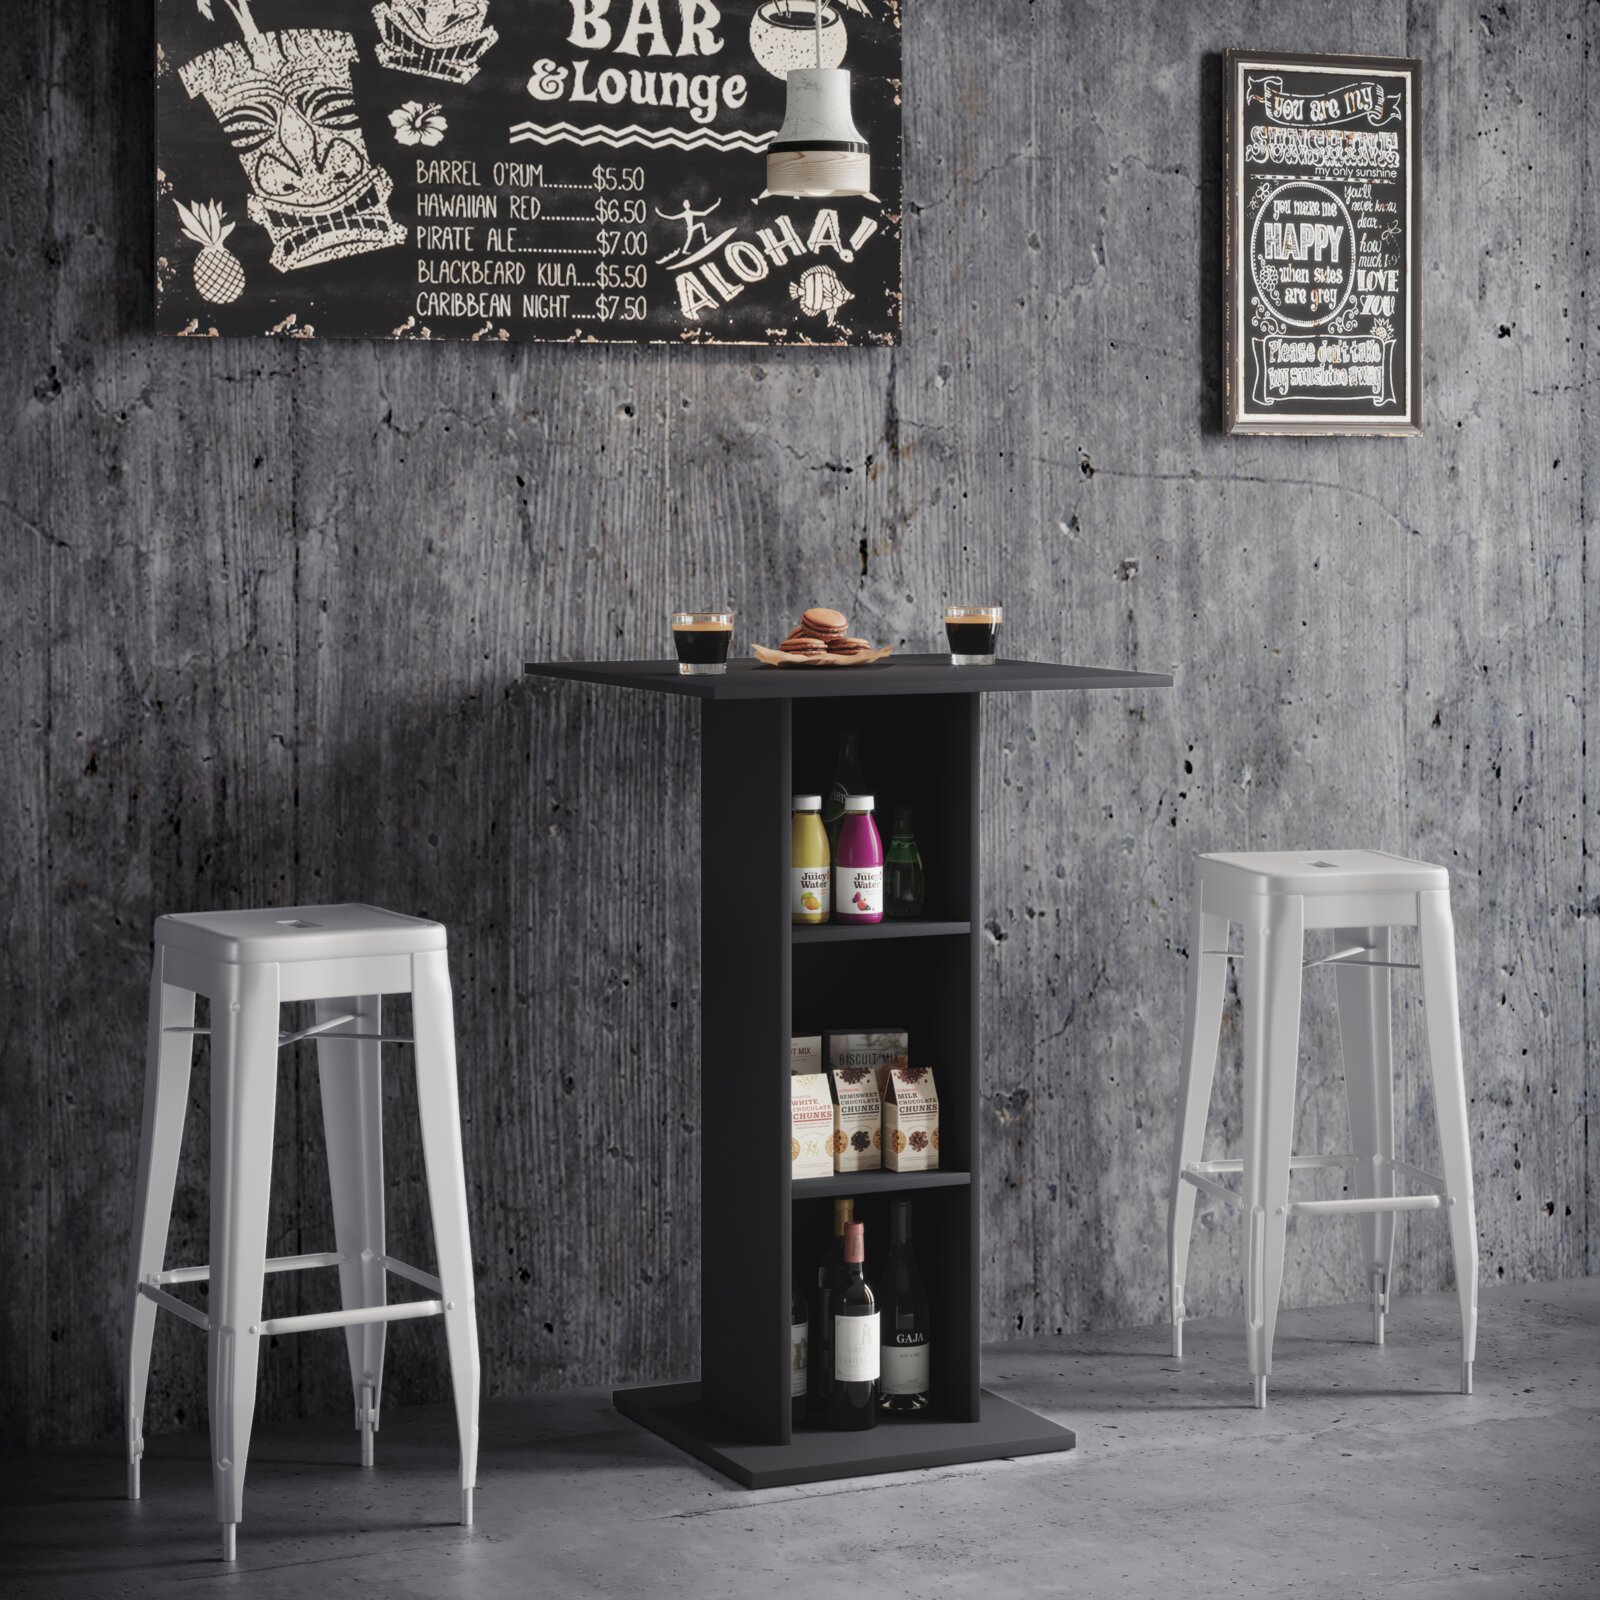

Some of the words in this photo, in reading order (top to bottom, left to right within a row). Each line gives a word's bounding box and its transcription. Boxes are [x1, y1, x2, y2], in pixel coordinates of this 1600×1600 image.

[566, 0, 724, 57] BAR
[1273, 95, 1304, 121] you
[1310, 98, 1340, 122] are
[1245, 125, 1400, 168] SUNSHINE
[416, 159, 481, 184] BARREL
[1314, 168, 1330, 178] my
[1332, 167, 1354, 179] only
[1355, 167, 1398, 178] sunshine
[416, 193, 497, 218] HAWAIIAN
[1273, 199, 1291, 221] you
[1293, 198, 1320, 217] make
[1321, 201, 1338, 217] me
[1351, 200, 1374, 212] never
[416, 226, 475, 252] PIRATE
[1263, 222, 1344, 263] HAPPY
[1359, 233, 1383, 253] how
[675, 208, 878, 321] ALOHA!
[1358, 254, 1382, 268] much
[418, 259, 526, 285] BLACKBEARD
[1279, 264, 1310, 284] when
[1313, 266, 1343, 285] skies
[1356, 269, 1399, 293] LOVE
[416, 291, 511, 318] CARIBBEAN
[523, 294, 571, 318] NIGHT
[1285, 288, 1306, 305] are
[1310, 287, 1338, 312] grey
[1359, 294, 1396, 317] YOU
[1268, 339, 1316, 364] Please
[1290, 363, 1348, 387] sunshine
[801, 873, 827, 881] Juicy
[853, 880, 880, 889] Water
[854, 873, 879, 882] Juicy
[798, 1047, 811, 1055] MIX
[840, 1054, 877, 1065] BISCUIT
[882, 1052, 900, 1064] MIX
[791, 1098, 818, 1106] WHITE
[792, 1104, 832, 1112] CHOCOLATE
[841, 1104, 880, 1113] CHUNKS
[898, 1097, 937, 1105] CHOCOLATE
[899, 1103, 938, 1113] CHUNKS
[793, 1111, 832, 1120] CHUNKS
[896, 1333, 924, 1344] GAJA
